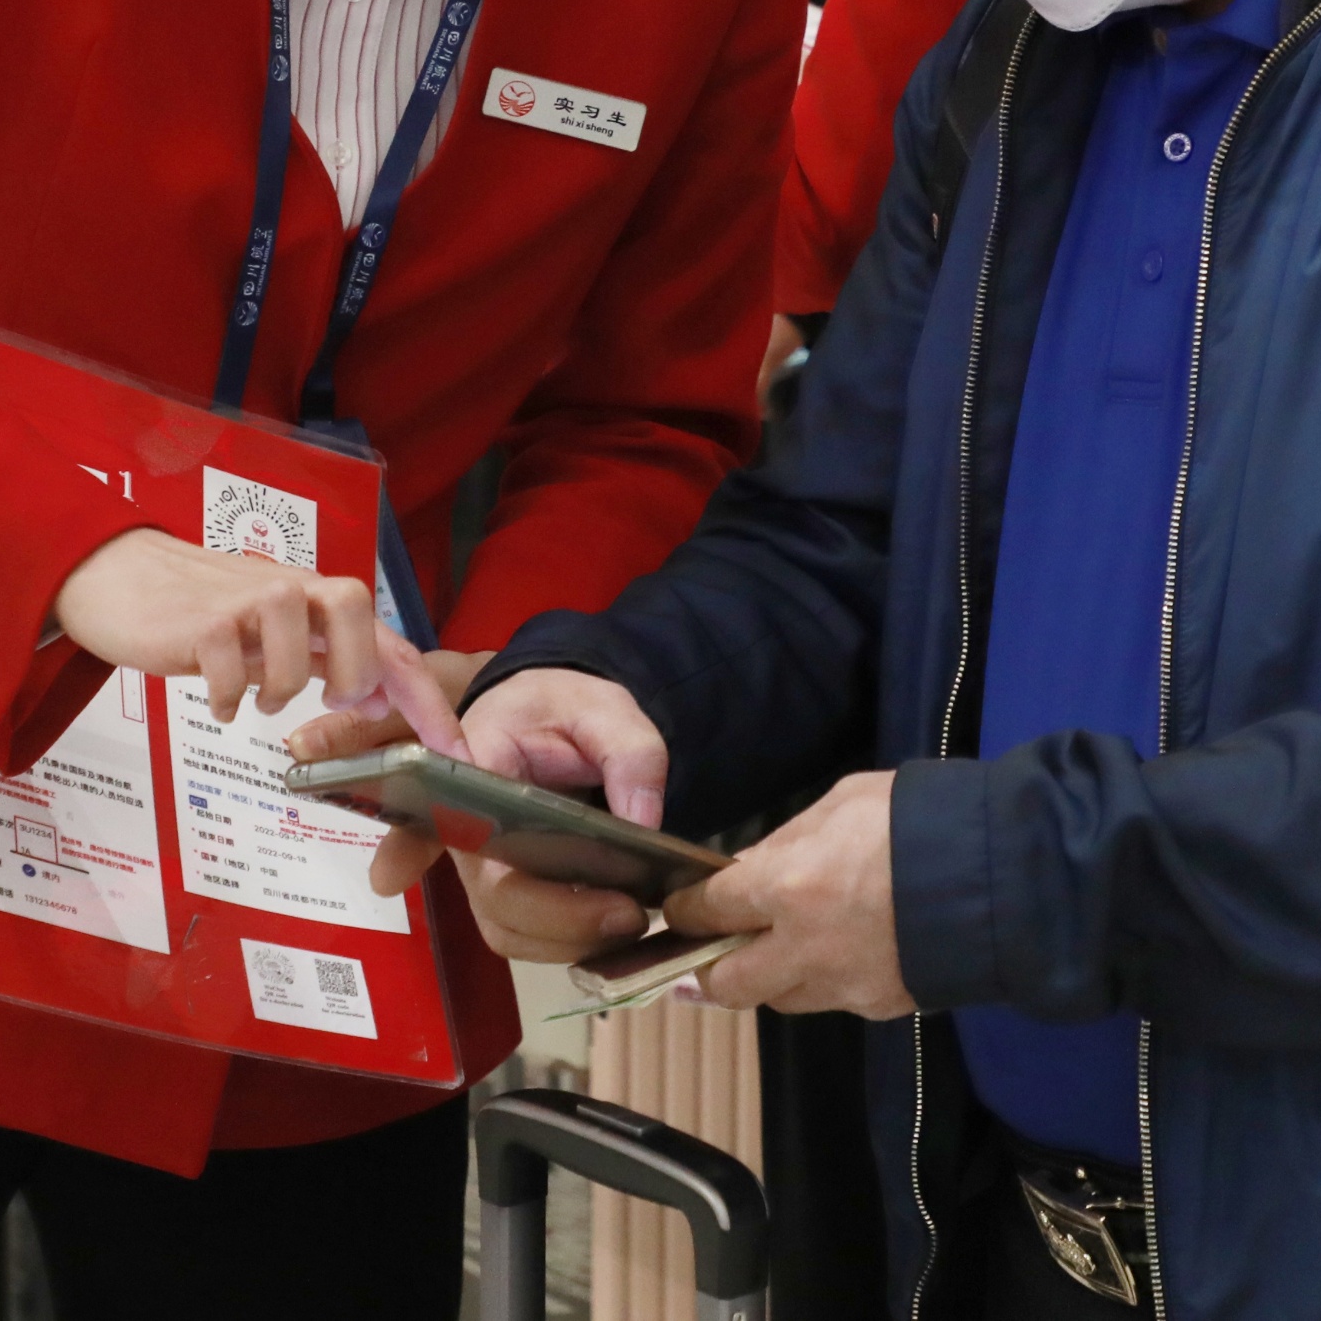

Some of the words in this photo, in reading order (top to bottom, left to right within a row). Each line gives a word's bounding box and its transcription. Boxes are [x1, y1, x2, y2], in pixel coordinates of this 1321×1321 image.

[433, 29, 448, 59] SICHUAN
[426, 31, 460, 95] 四川航空
[420, 59, 436, 90] AIRLINES
[553, 97, 627, 127] 实习生
[560, 116, 575, 126] shi
[576, 120, 585, 129] xi
[586, 122, 614, 137] sheng
[187, 718, 222, 735] 地区选择
[196, 809, 232, 825] 起始日期
[19, 824, 52, 839] 3U1234
[198, 830, 235, 847] 结束日期
[254, 824, 305, 843] 2022-09-04
[200, 851, 250, 872] 国家（地区）
[257, 846, 307, 864] 2022-09-18
[203, 873, 239, 889] 地区选择
[260, 866, 278, 877] 中国
[24, 894, 77, 915] 1312345678
[263, 887, 347, 911] 四川省成都市双流区
